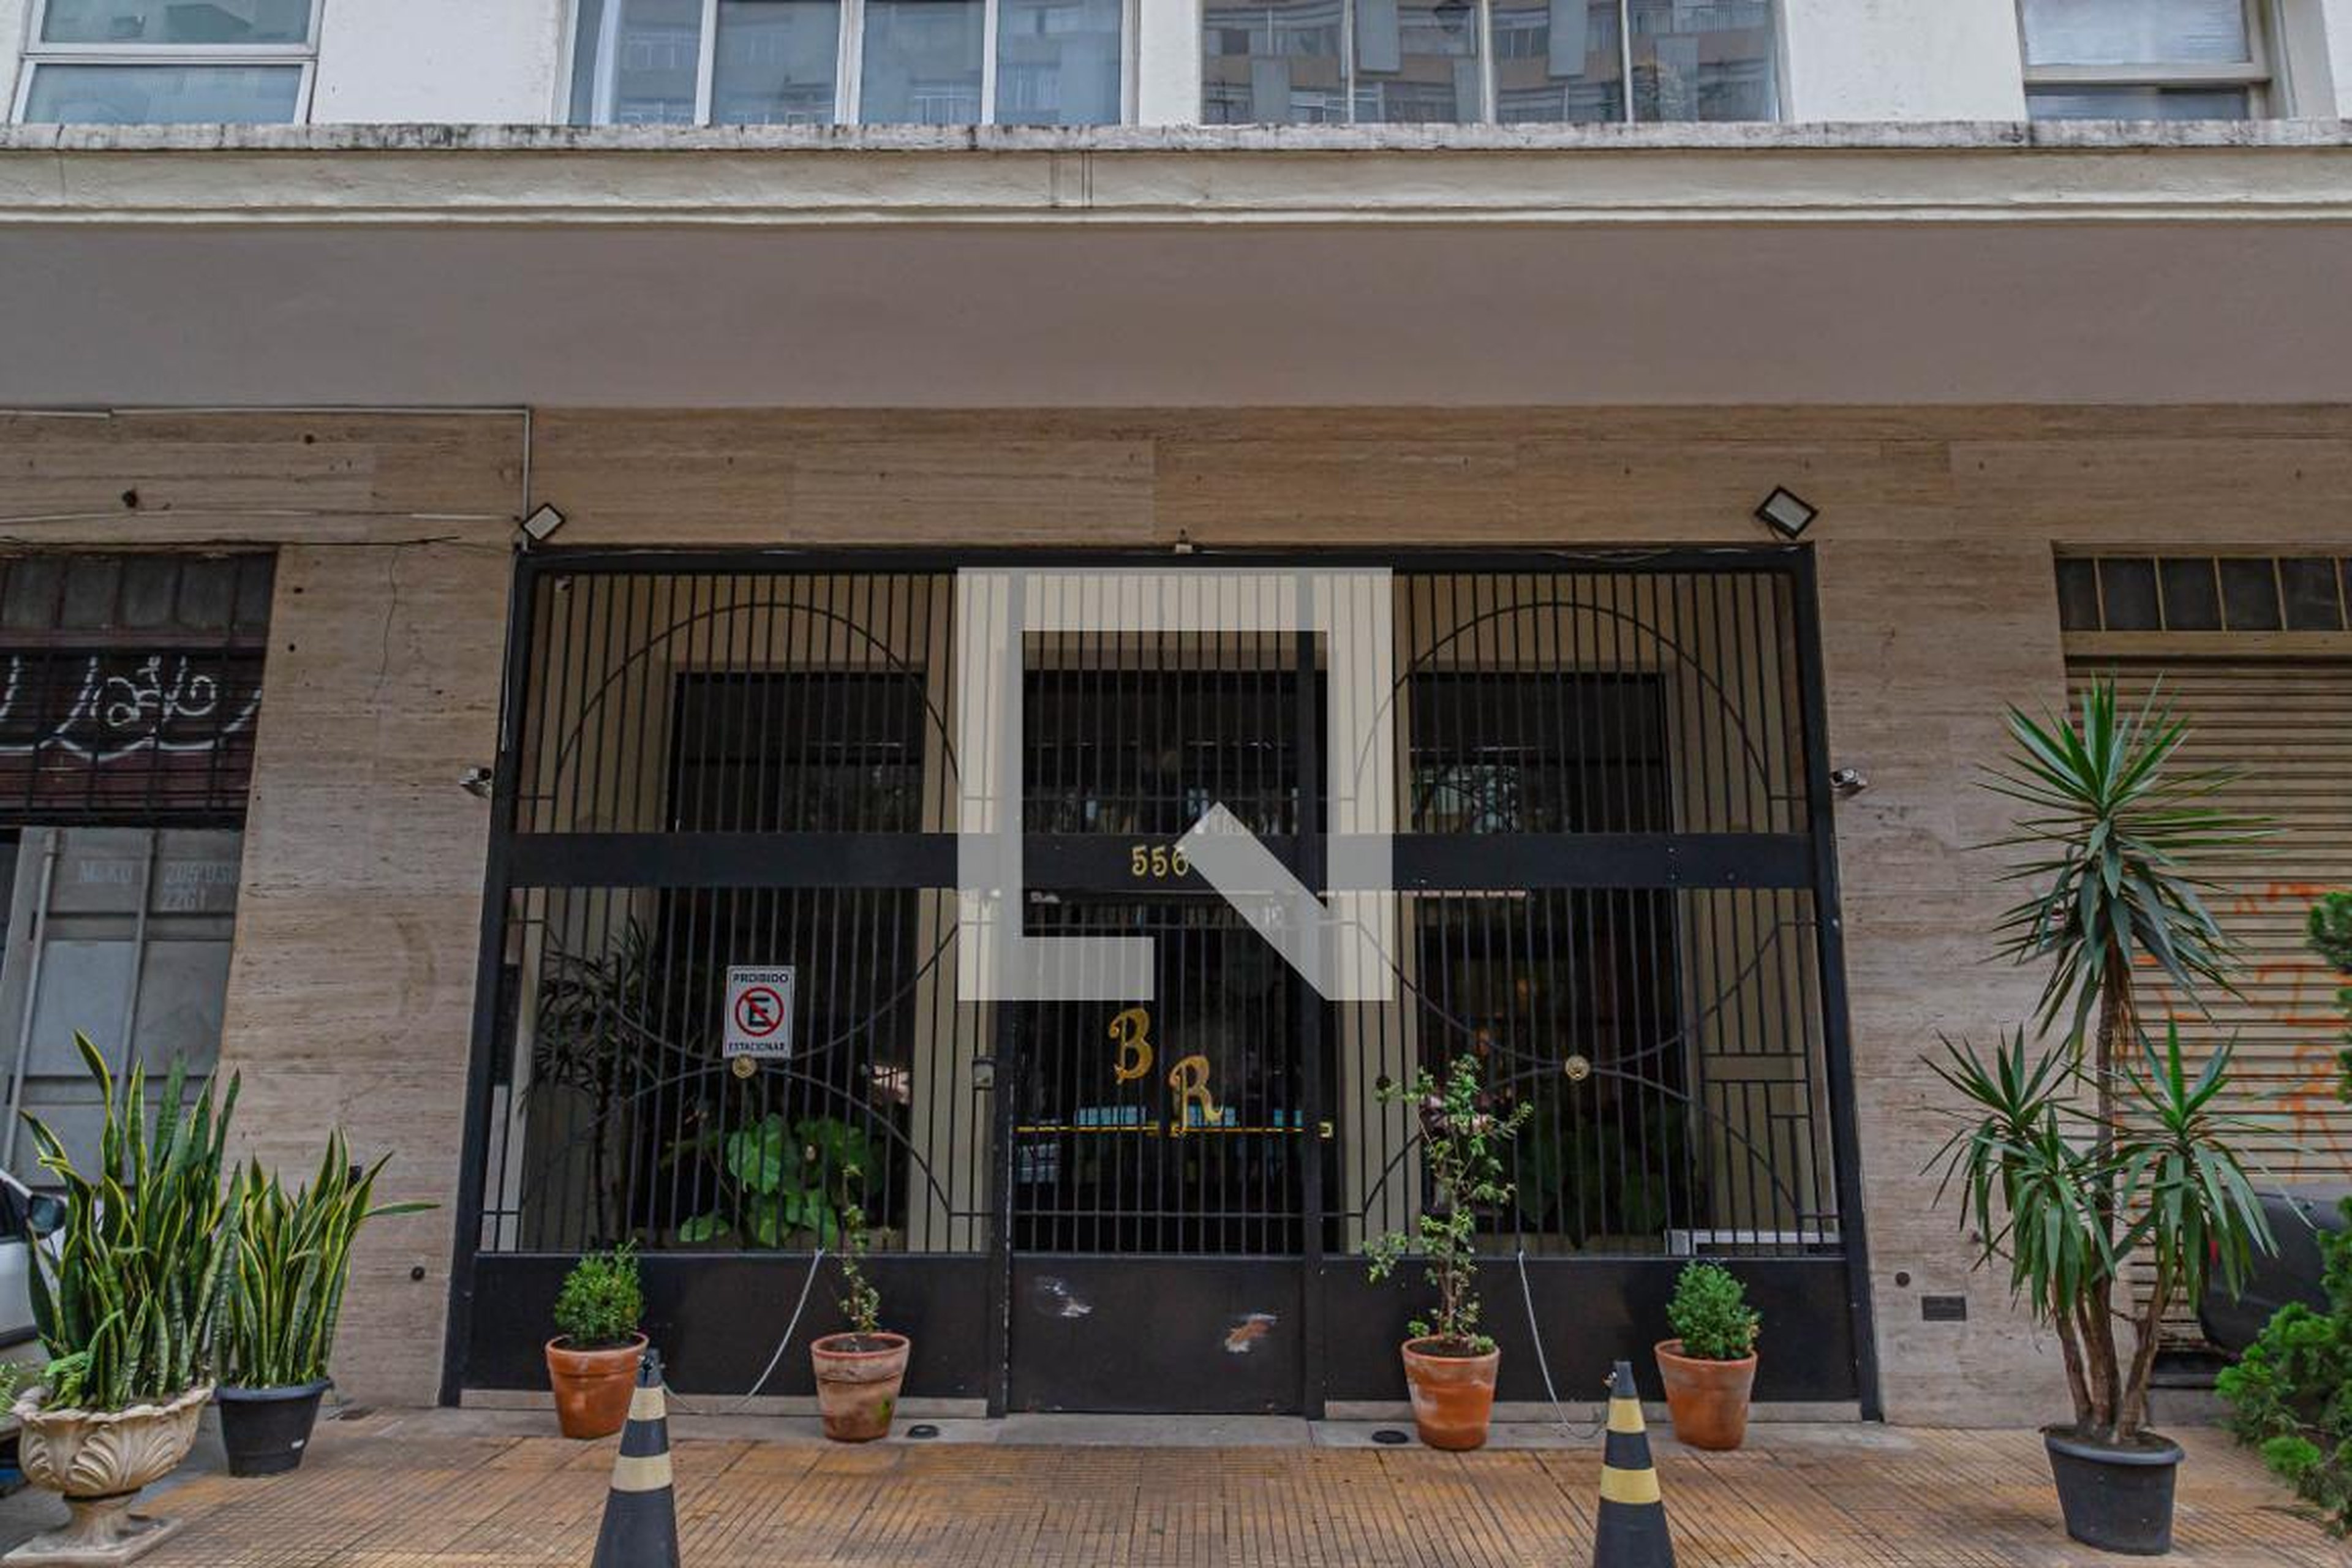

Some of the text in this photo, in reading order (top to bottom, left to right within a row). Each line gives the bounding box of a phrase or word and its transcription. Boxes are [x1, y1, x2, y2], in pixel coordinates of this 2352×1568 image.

[1131, 844, 1189, 878] 556
[732, 973, 789, 983] PROIBIDO
[728, 1041, 785, 1052] ESTACIONAR
[1108, 1006, 1154, 1086] B
[1168, 1054, 1223, 1137] R
